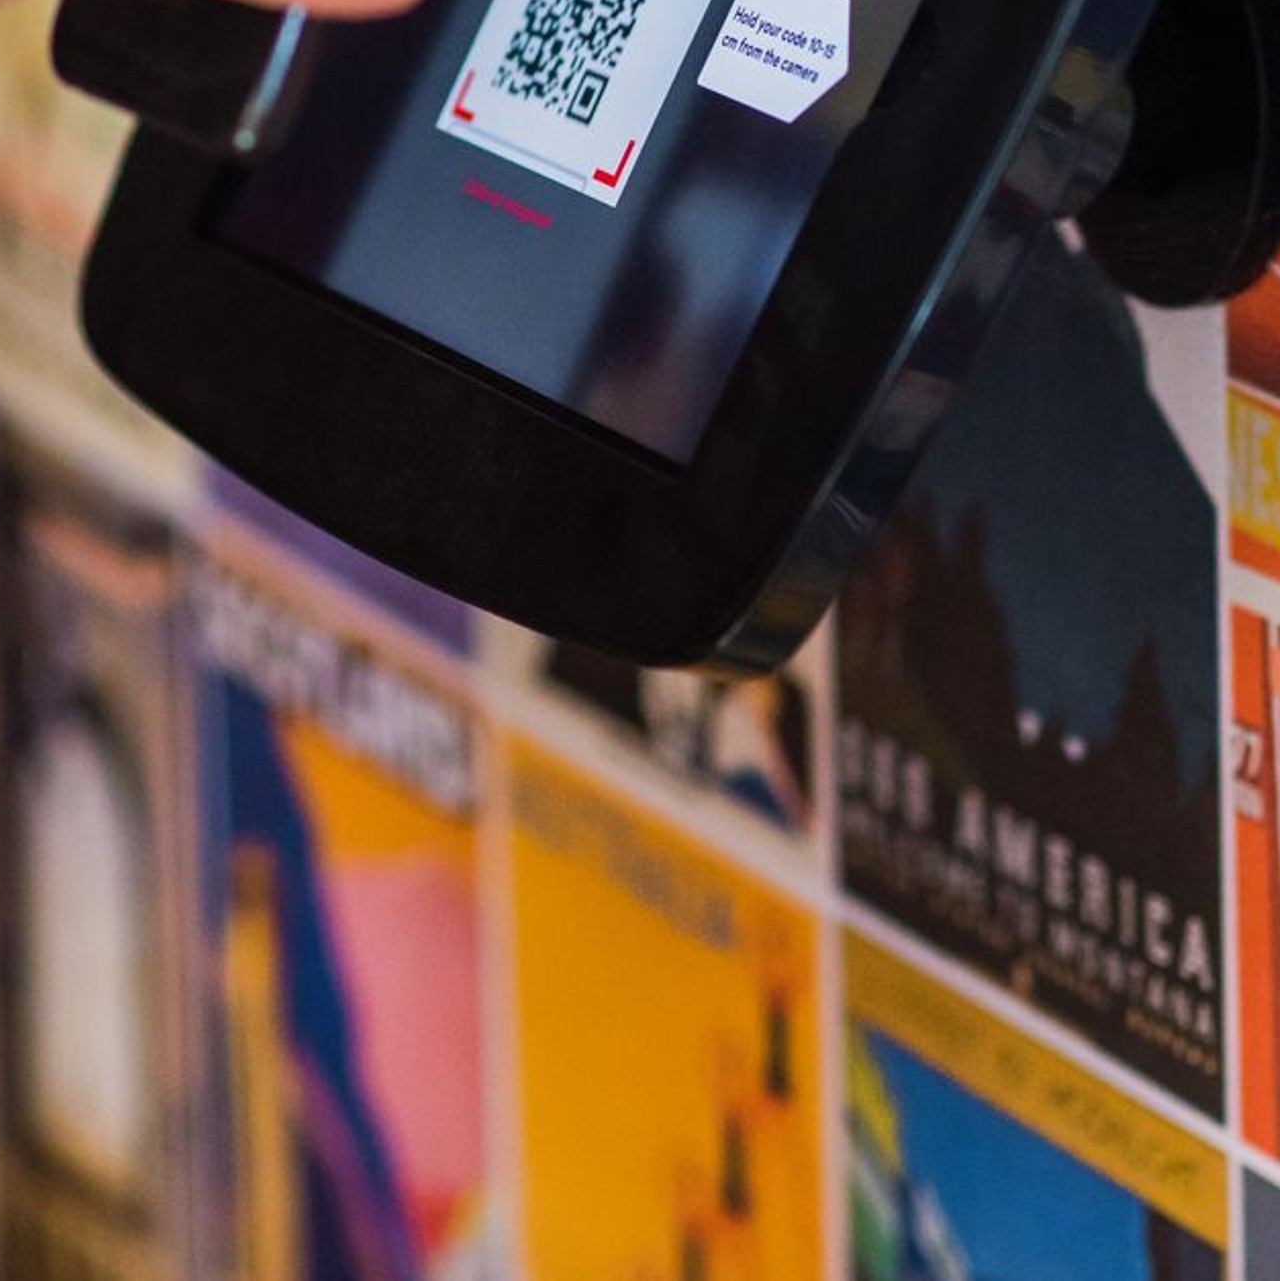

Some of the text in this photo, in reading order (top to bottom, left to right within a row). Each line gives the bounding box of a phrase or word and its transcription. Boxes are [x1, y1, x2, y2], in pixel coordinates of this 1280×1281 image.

[721, 33, 820, 84] cm from the camera
[732, 7, 838, 60] Hold your code 10-15
[955, 785, 1216, 994] AMERICA
